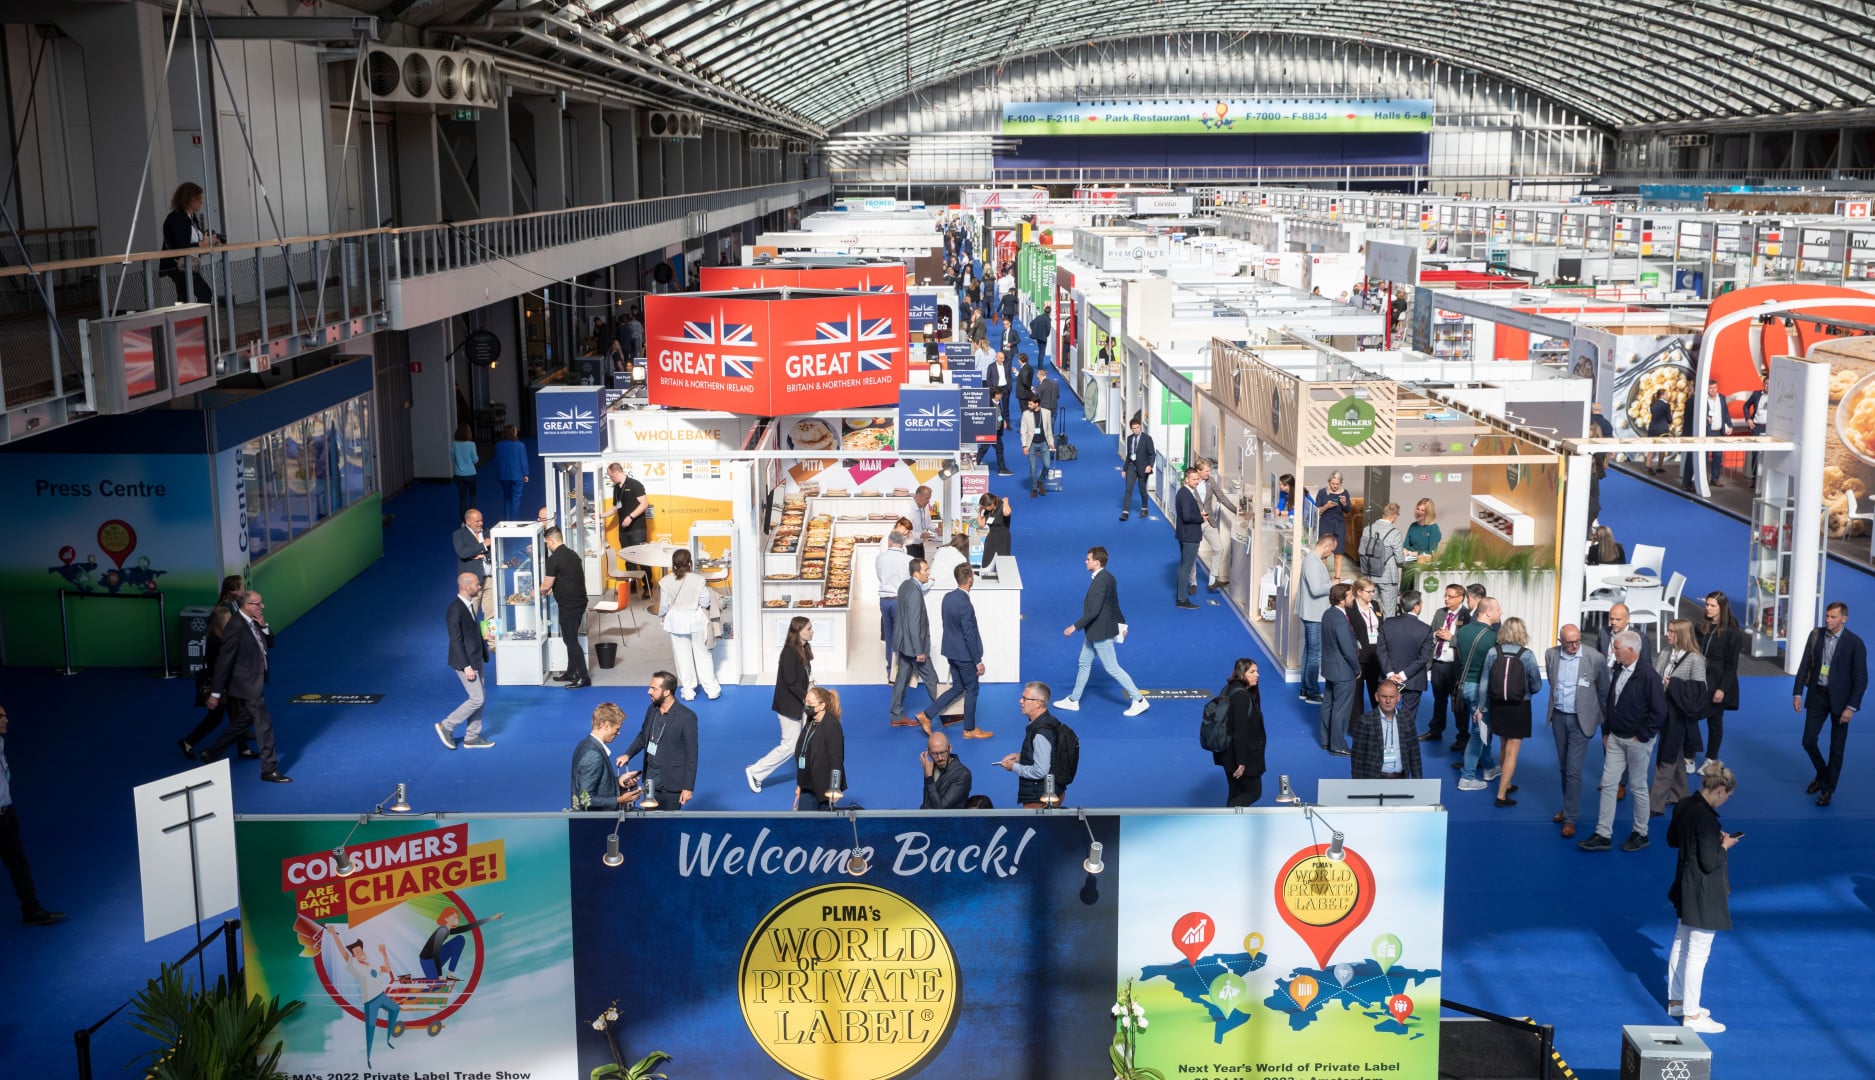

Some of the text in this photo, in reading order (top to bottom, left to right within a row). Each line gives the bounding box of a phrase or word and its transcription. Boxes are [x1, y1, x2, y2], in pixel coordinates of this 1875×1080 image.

[1007, 114, 1036, 123] F-100
[1046, 114, 1080, 123] F-2118
[1105, 113, 1190, 122] Park Restaurant
[1245, 112, 1281, 121] F-7000
[1292, 112, 1328, 121] F-8834
[1374, 111, 1401, 120] Halls
[659, 349, 716, 376] GREAT
[785, 352, 852, 378] GREAT
[660, 376, 754, 393] BRITAIN & NORTHERN IRELAND
[786, 375, 892, 393] BRITAIN & NORTHERN IRELAND
[543, 421, 574, 430] GREAT
[904, 418, 935, 428] GREAT
[1330, 418, 1373, 427] BRINKERS
[634, 429, 721, 441] WHOLEBAKE
[802, 459, 825, 471] PITTA
[859, 459, 882, 471] NAAN
[915, 459, 944, 471] TORTILL
[36, 480, 167, 497] Press Centre
[235, 448, 248, 553] Centre
[891, 825, 1037, 878] Back!
[348, 853, 498, 906] CHARGE!
[1295, 869, 1352, 882] WORLD
[305, 885, 335, 899] ARE
[1288, 883, 1354, 897] PRIVATE
[299, 893, 340, 911] BACK
[314, 906, 331, 918] IN
[766, 927, 936, 963] WORLD
[797, 957, 821, 972] OF
[752, 968, 945, 1004] PRIVATE
[1178, 1064, 1209, 1073] Next
[1255, 1063, 1293, 1073] World
[1297, 1062, 1310, 1072] of
[1314, 1062, 1360, 1072] Private
[1364, 1062, 1400, 1071] Label
[363, 1071, 410, 1080] Private
[414, 1071, 450, 1080] Label
[454, 1071, 492, 1080] Trade
[495, 1070, 531, 1080] Show
